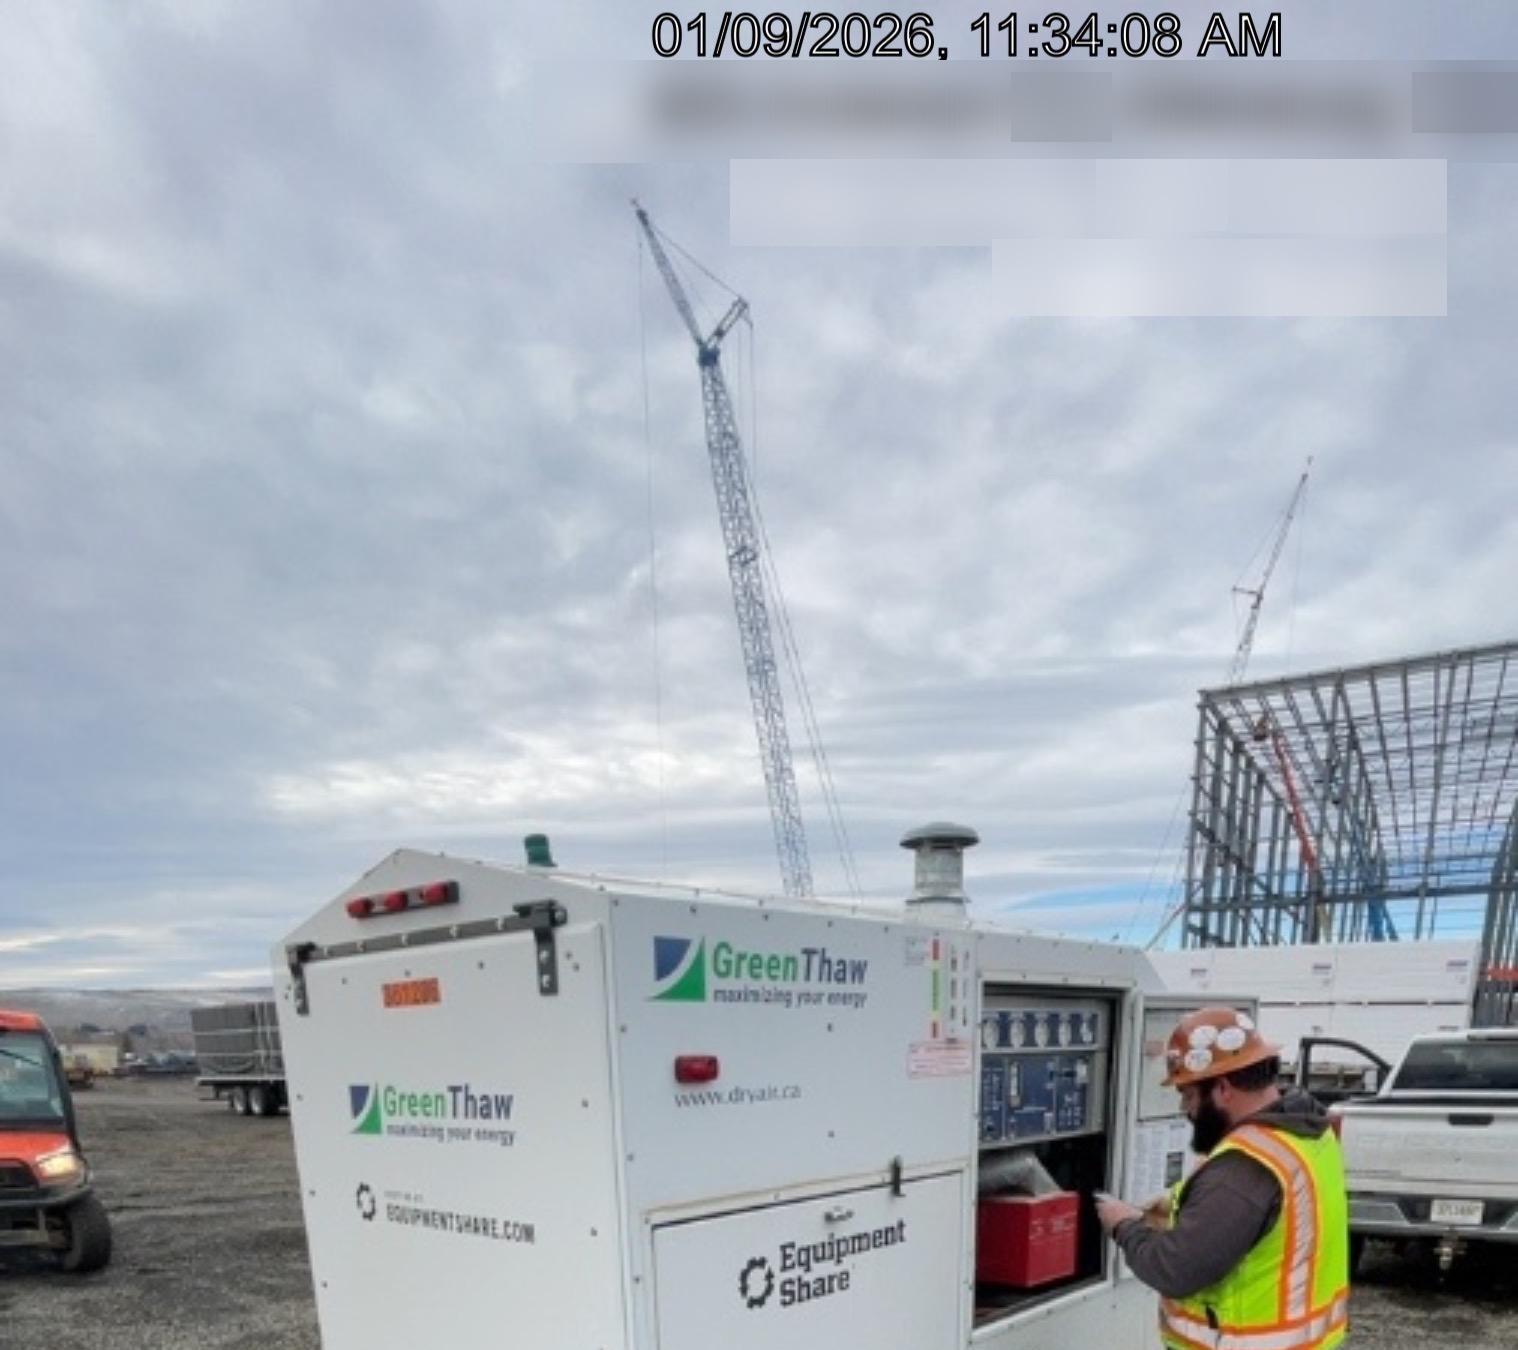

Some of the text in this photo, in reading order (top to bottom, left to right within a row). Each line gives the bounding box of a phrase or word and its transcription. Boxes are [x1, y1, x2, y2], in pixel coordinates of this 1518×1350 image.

[713, 941, 868, 985] GreenThaw
[713, 985, 868, 1009] maximizing your energy
[383, 1083, 514, 1120] GreenThaw
[386, 1203, 535, 1244] EQUIPMENTSHARE.COM
[779, 1219, 906, 1272] Equipment
[779, 1269, 850, 1307] Share
